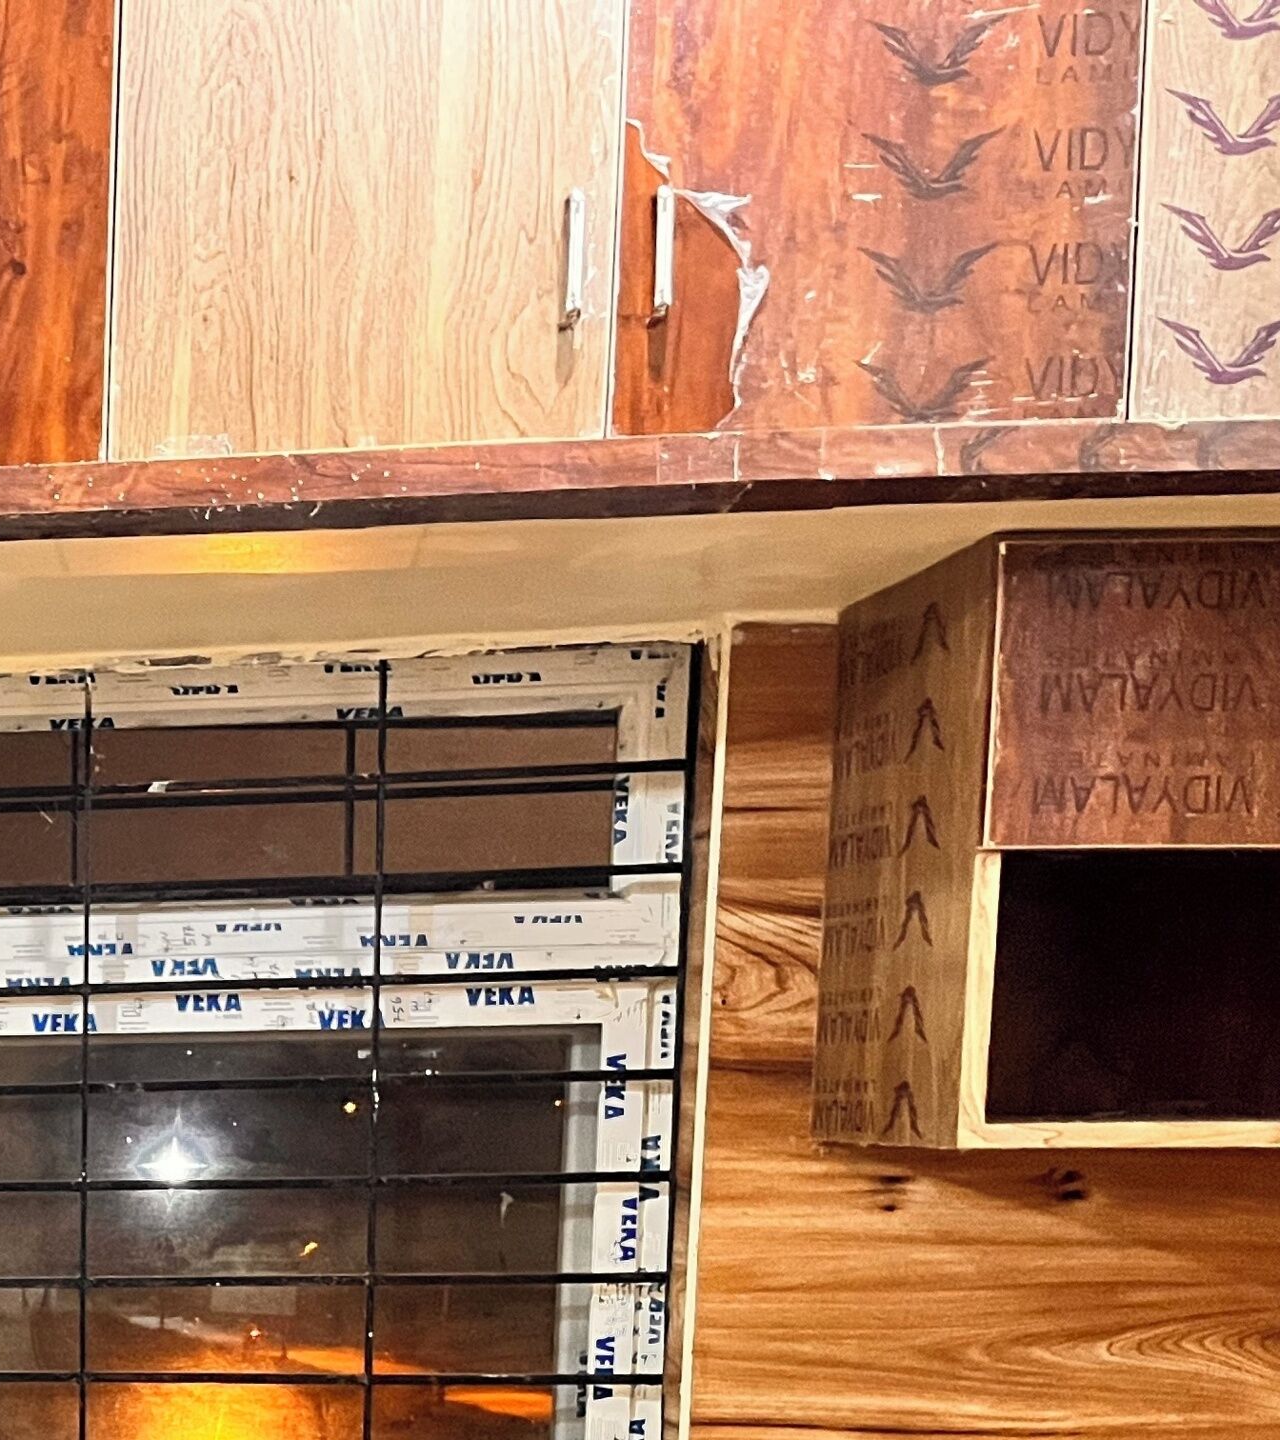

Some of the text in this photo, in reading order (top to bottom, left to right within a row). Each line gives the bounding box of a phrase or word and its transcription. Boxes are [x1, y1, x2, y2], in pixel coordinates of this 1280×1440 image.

[1040, 672, 1260, 712] VIDYALAM
[1033, 774, 1253, 815] VIDYALAM
[151, 958, 224, 979] VEKA
[445, 952, 514, 969] VEKA
[175, 993, 242, 1012] VEKA
[465, 986, 535, 1006] VEKA
[32, 1013, 98, 1032] VEKA
[620, 1197, 637, 1261] VEKA
